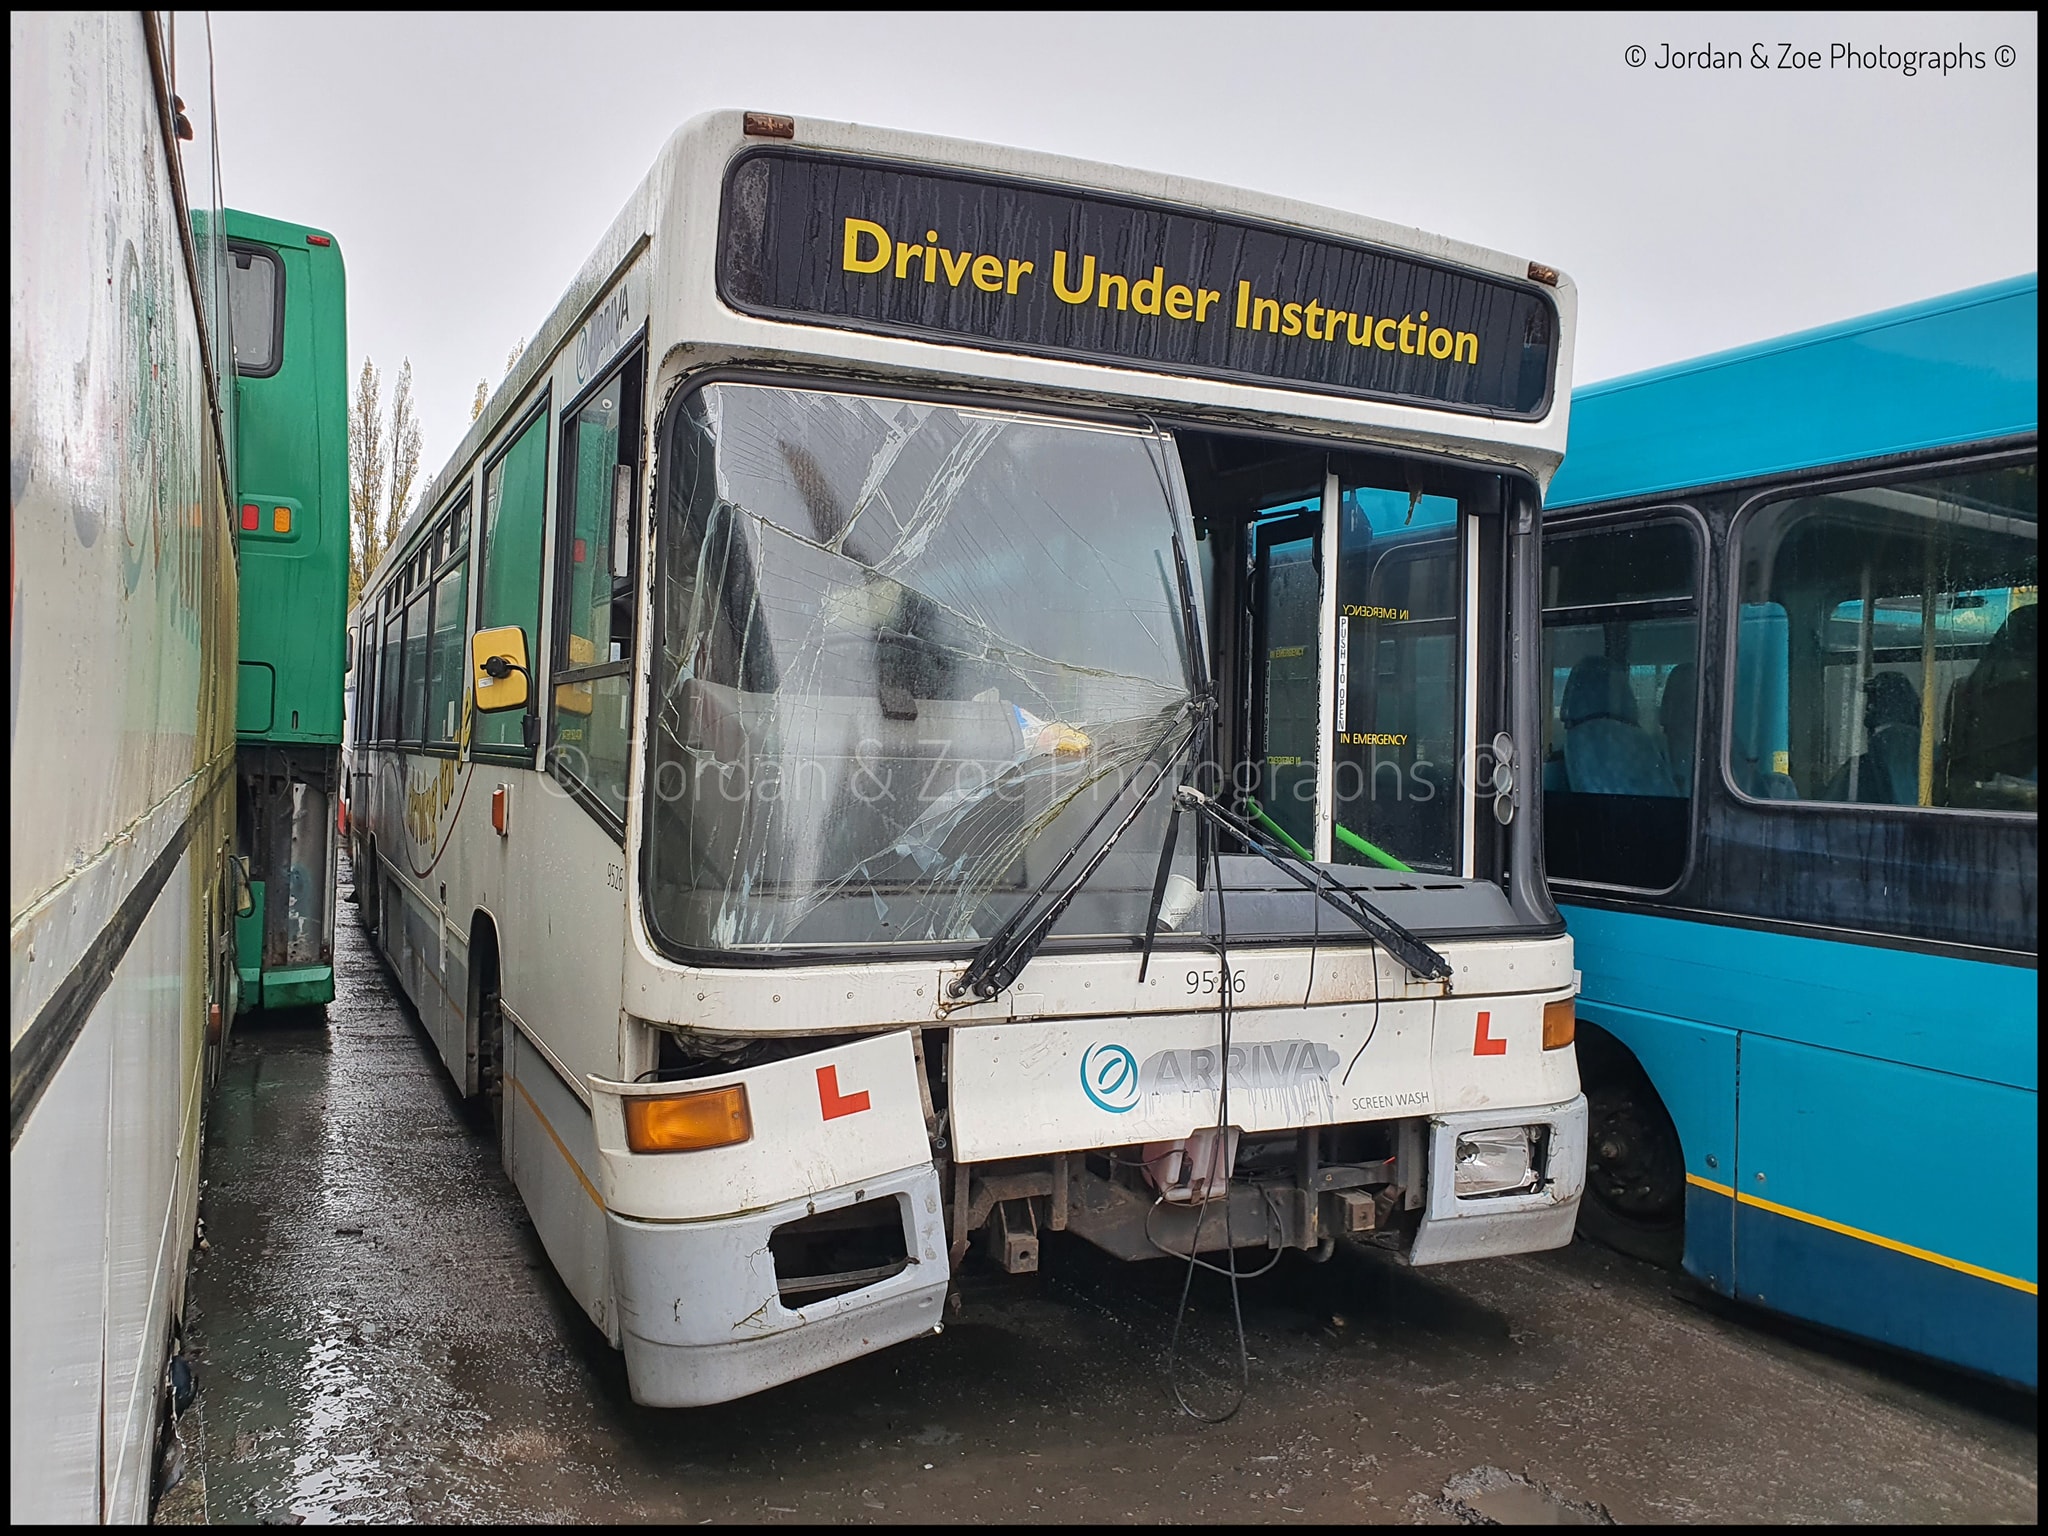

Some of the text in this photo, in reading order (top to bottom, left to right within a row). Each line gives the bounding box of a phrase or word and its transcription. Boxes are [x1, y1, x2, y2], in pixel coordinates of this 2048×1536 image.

[842, 217, 1480, 366] Driver Under Instruction
[1340, 664, 1346, 684] TO
[1340, 733, 1408, 746] IN EMERGENCY
[607, 862, 624, 892] 9526
[1473, 1011, 1507, 1056] L
[1155, 1041, 1325, 1089] ARRIVA
[816, 1064, 871, 1121] L
[1352, 1091, 1430, 1110] SCREEN WASH
